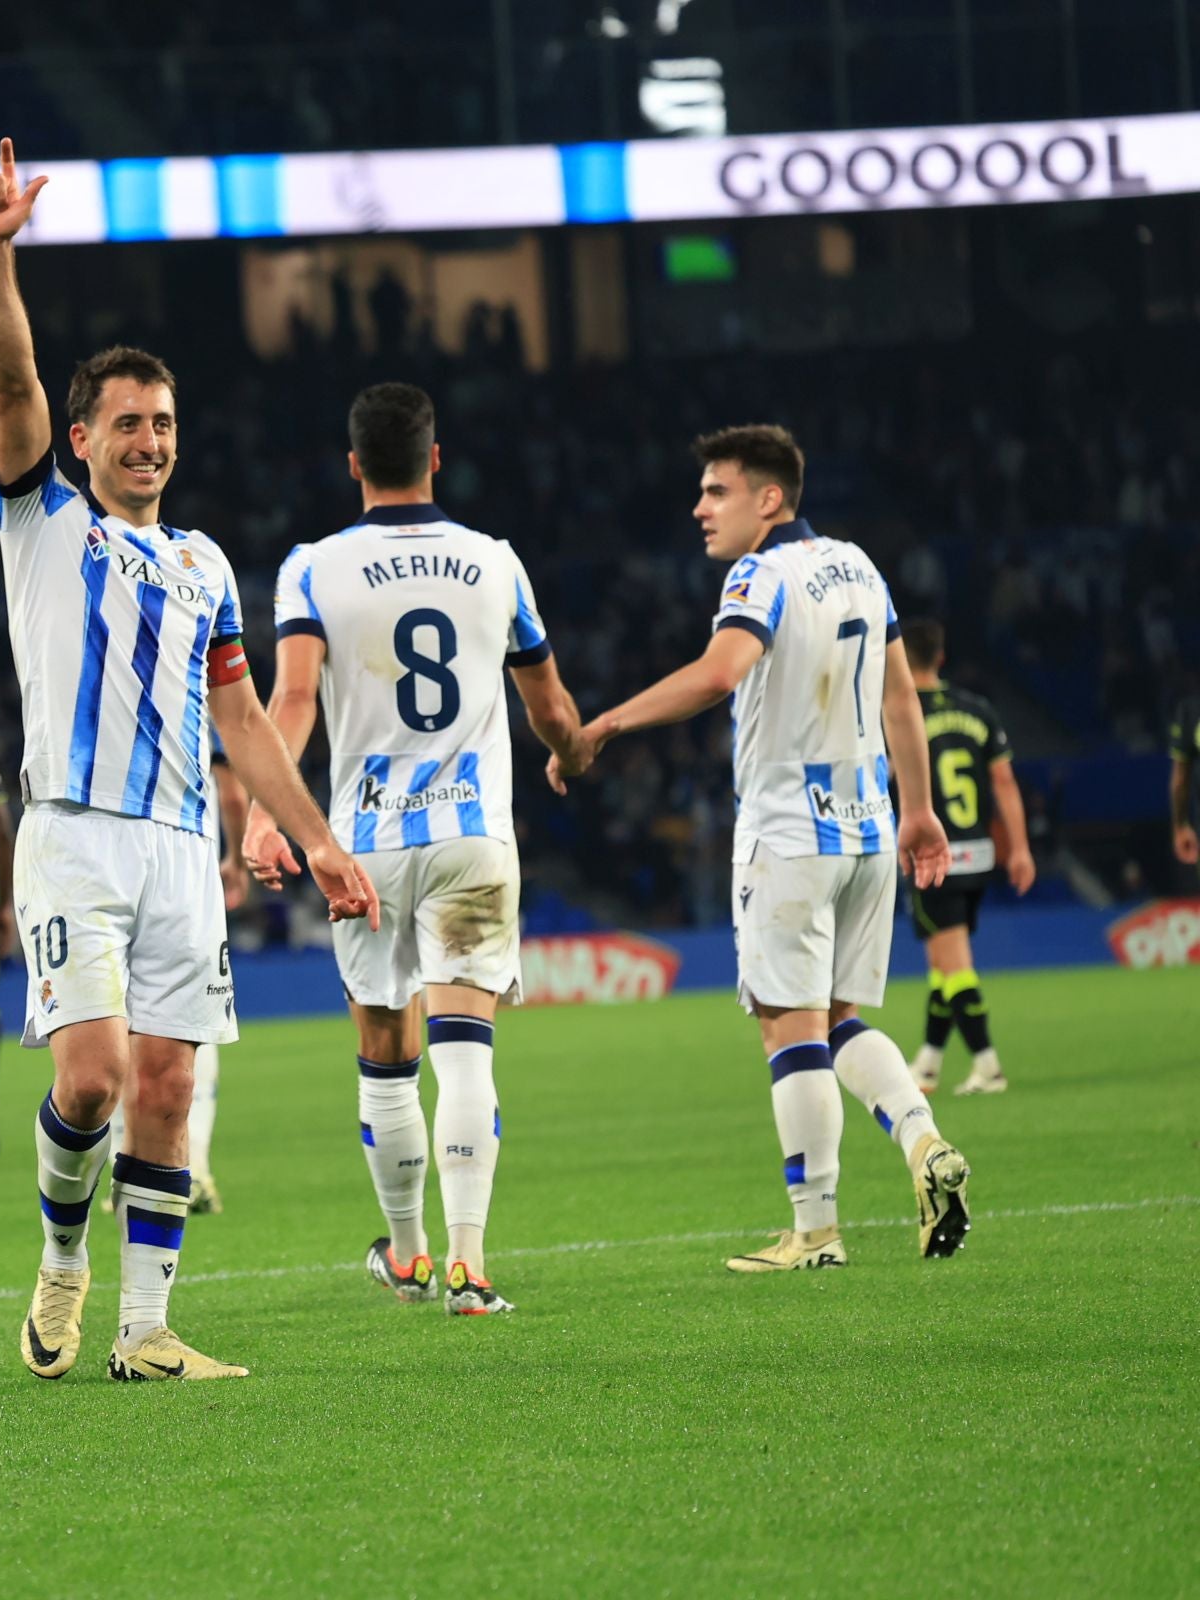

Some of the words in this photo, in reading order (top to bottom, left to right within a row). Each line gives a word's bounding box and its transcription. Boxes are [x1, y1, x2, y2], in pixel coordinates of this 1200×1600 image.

[719, 131, 1150, 205] GOOOOOL
[118, 554, 210, 608] YASDA
[362, 554, 482, 589] MERINO
[394, 608, 461, 732] 8
[837, 617, 869, 738] 7
[937, 747, 979, 830] 5
[30, 914, 69, 978] 10
